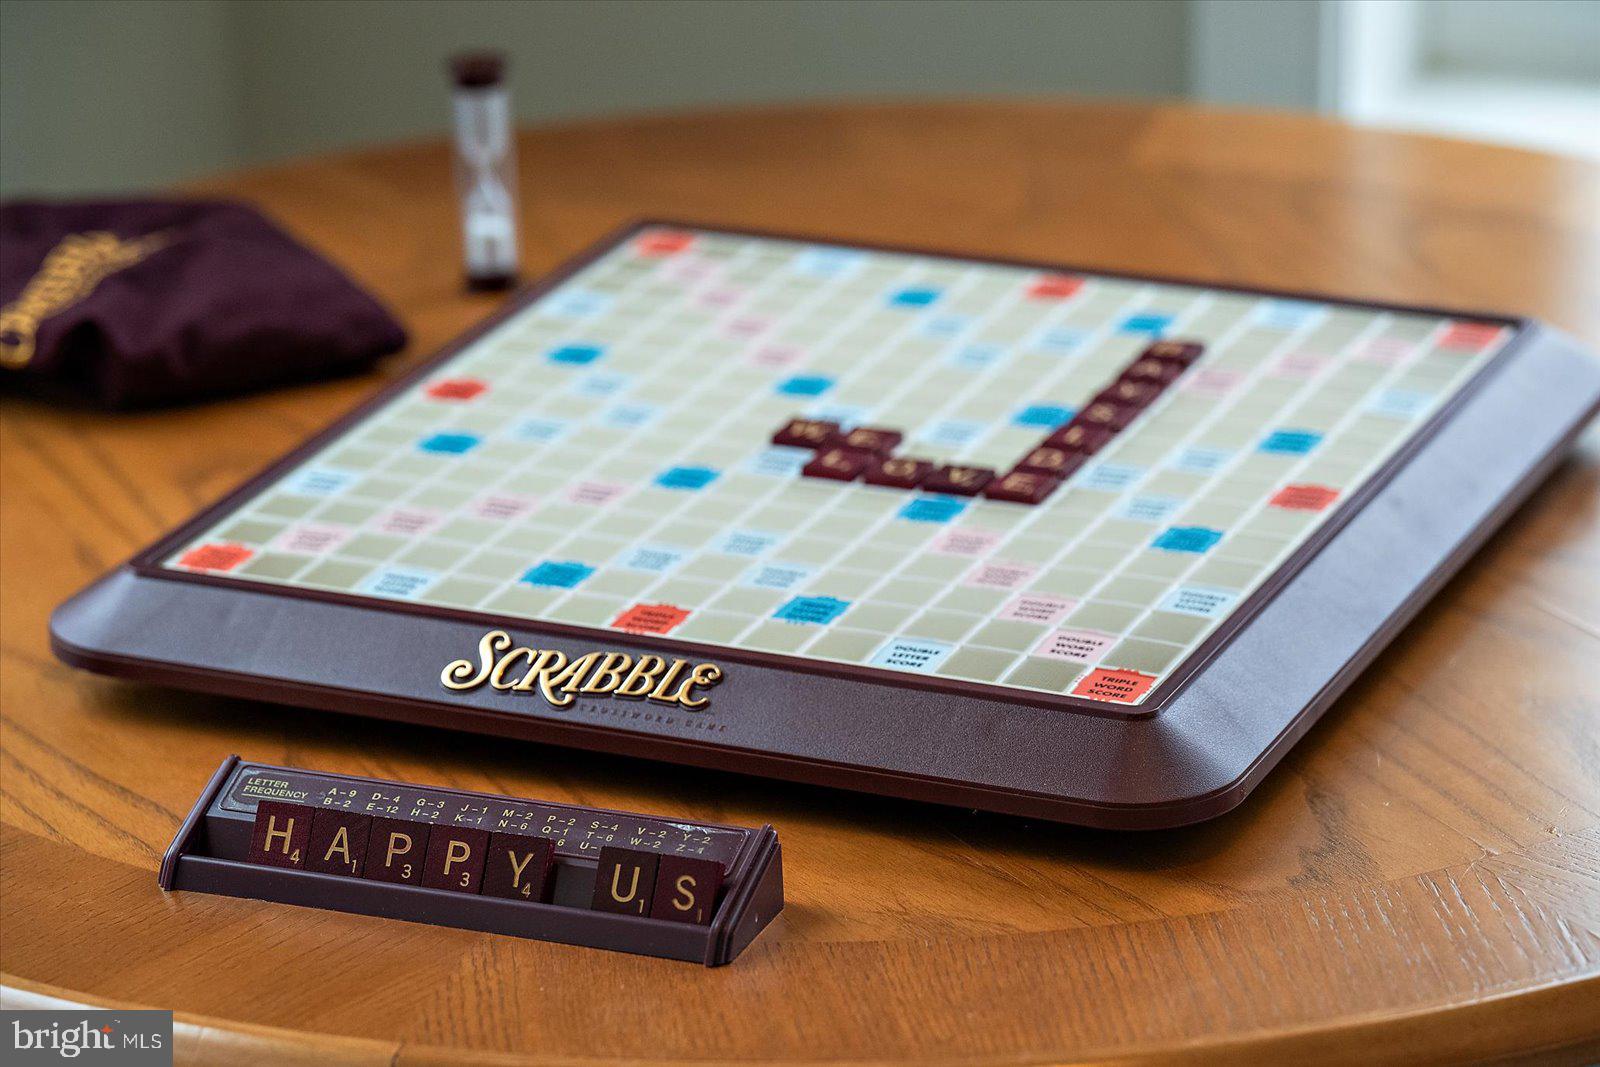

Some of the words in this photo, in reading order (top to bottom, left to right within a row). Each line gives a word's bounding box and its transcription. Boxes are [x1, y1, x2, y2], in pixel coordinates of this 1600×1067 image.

[440, 630, 723, 706] SCRABBLE
[1102, 676, 1139, 686] TRIPLE
[1094, 682, 1133, 693] WORD
[1087, 689, 1127, 699] SCORE
[248, 777, 289, 788] LETTER
[243, 785, 309, 799] FREQUENCY
